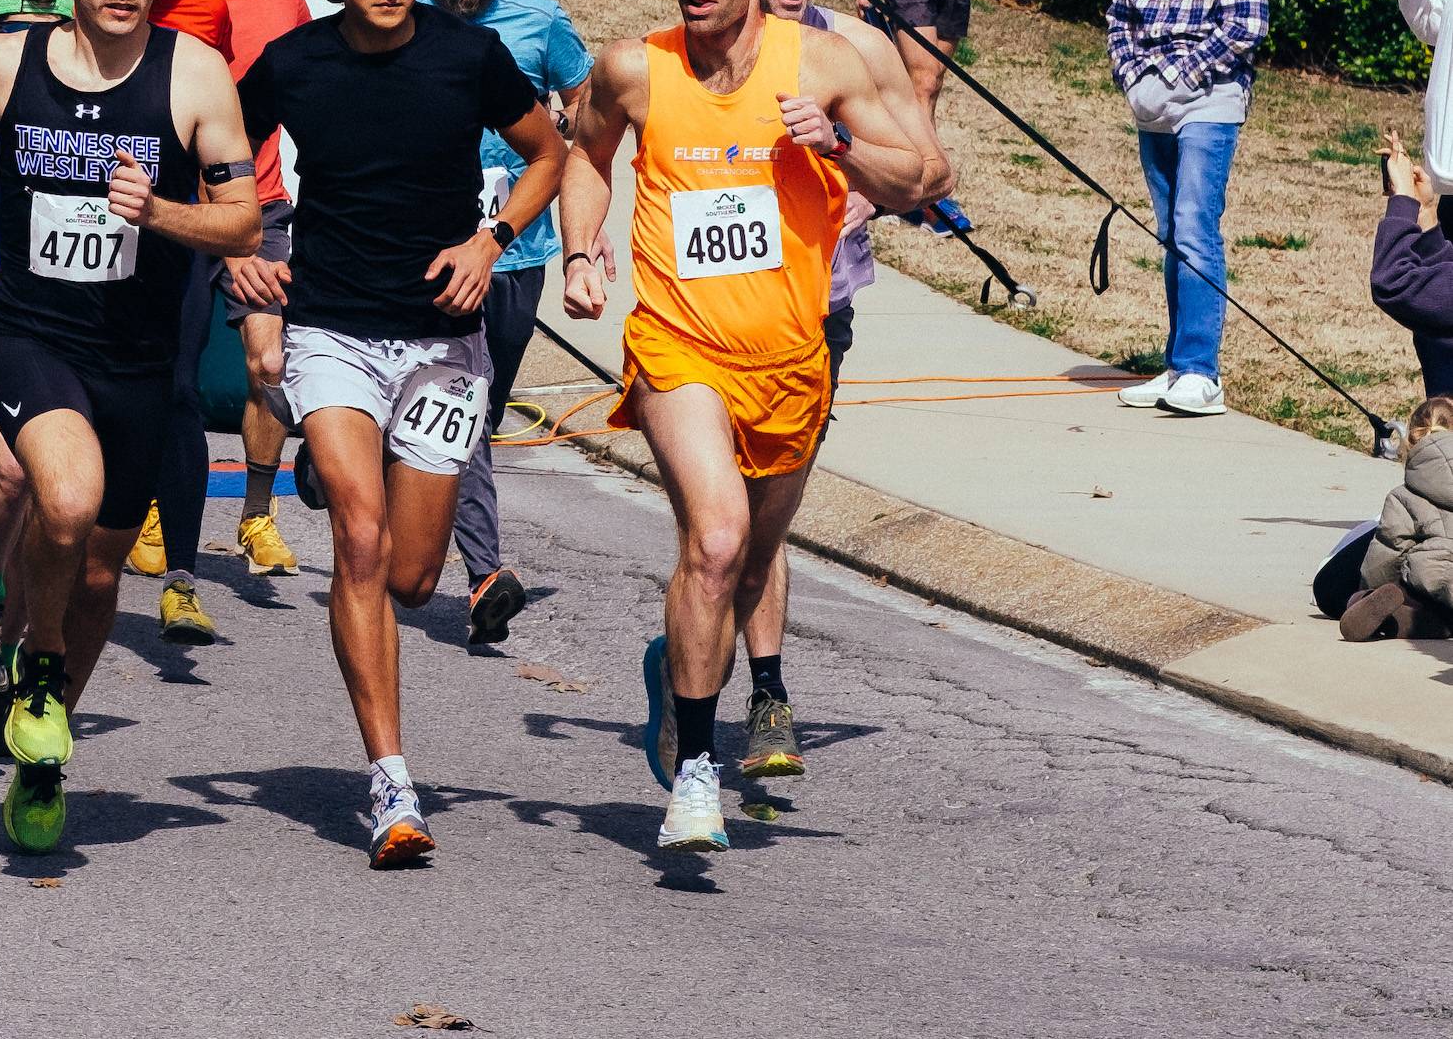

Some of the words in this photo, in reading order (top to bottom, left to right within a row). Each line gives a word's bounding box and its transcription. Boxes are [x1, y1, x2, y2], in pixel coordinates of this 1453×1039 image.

[15, 124, 160, 161] TENNESSEE
[674, 147, 721, 161] FLEET
[743, 147, 782, 161] FEET
[16, 150, 159, 186] WESLEYN
[98, 214, 106, 225] 6
[737, 203, 746, 214] 6
[40, 230, 124, 270] 4707
[687, 221, 768, 264] 4803
[466, 390, 474, 401] 6
[404, 396, 477, 449] 4761
